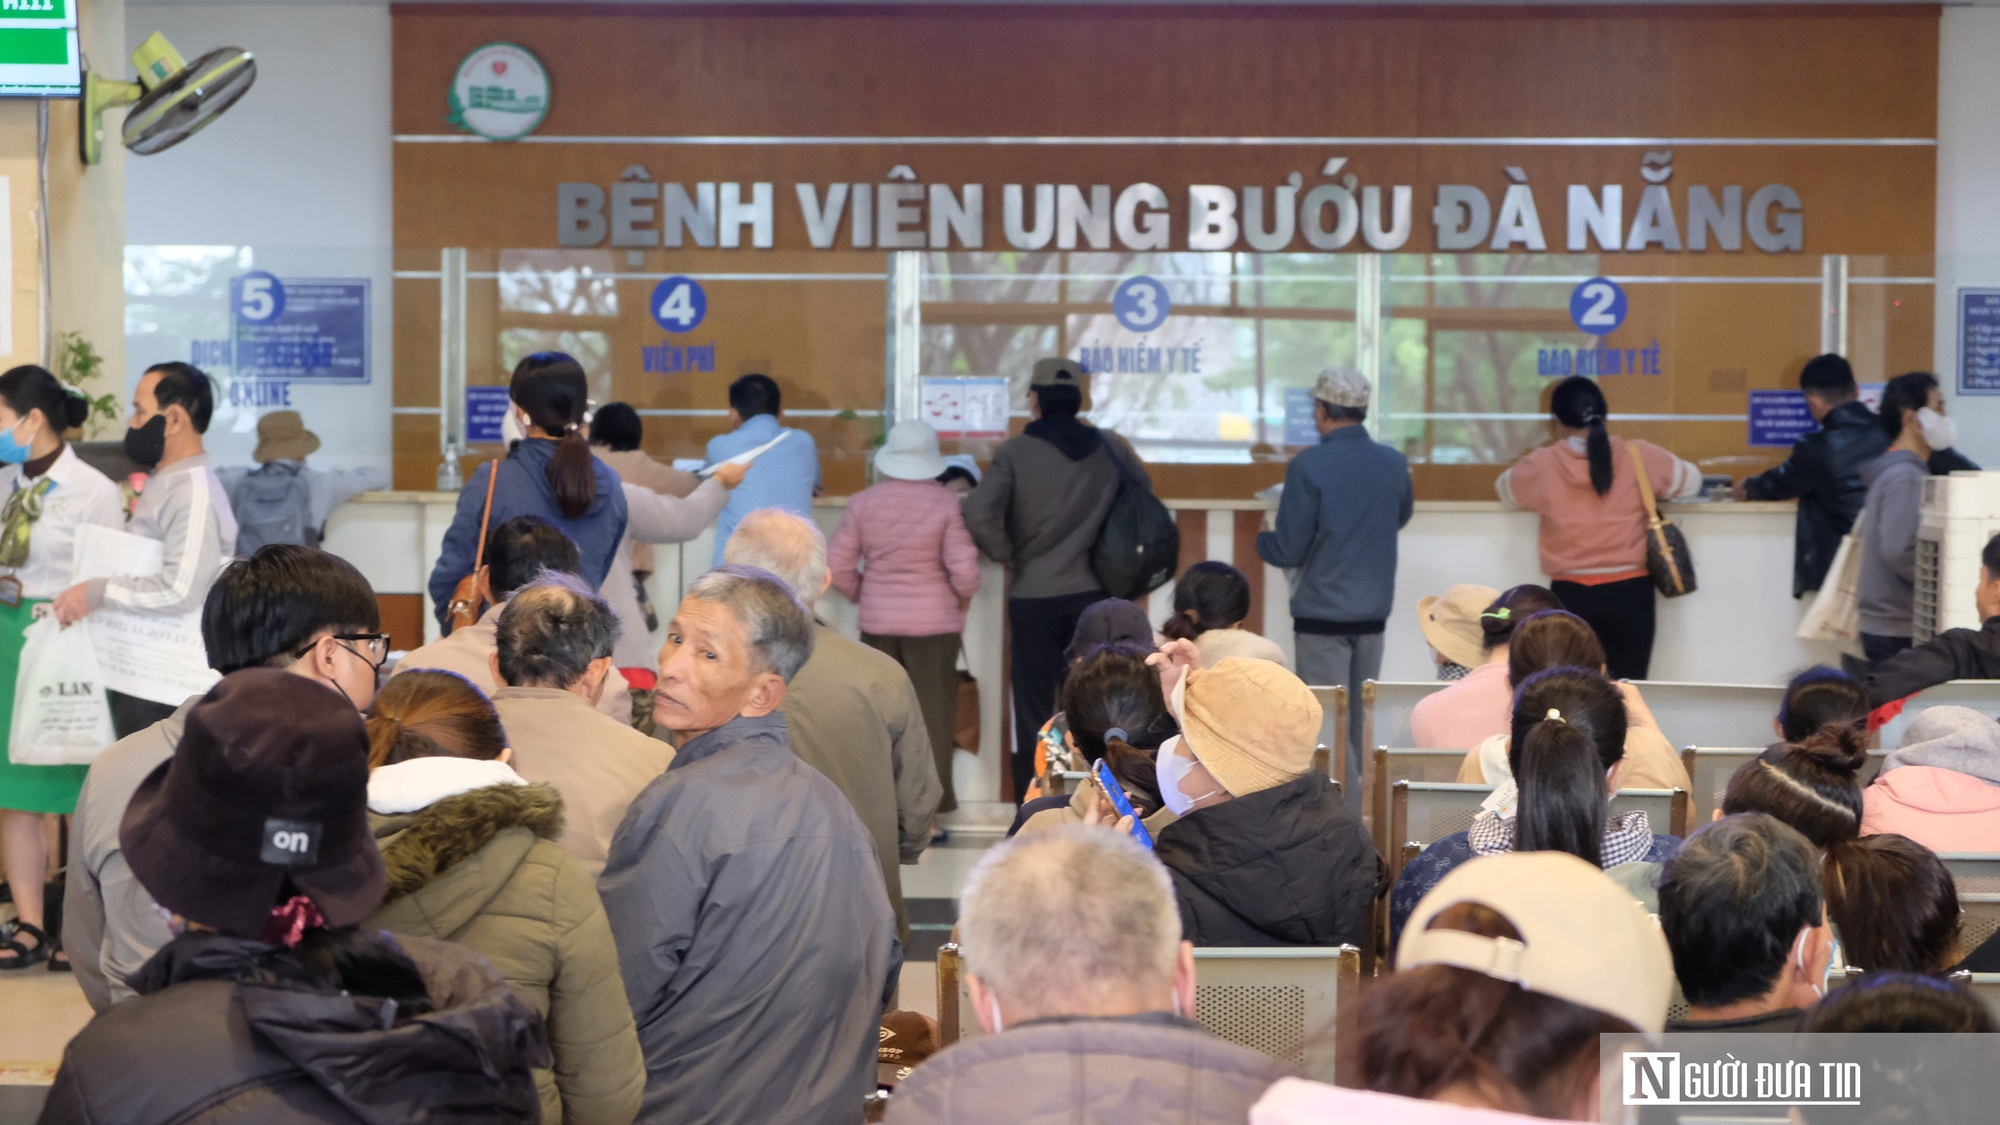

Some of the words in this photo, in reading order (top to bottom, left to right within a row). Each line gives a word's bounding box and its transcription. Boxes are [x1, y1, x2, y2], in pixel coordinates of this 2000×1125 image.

[558, 165, 773, 266] BỆNH
[1003, 182, 1171, 250] UNG
[1188, 157, 1412, 250] BƯỚU
[1433, 166, 1547, 250] ĐÀ
[1566, 150, 1803, 252] NẴNG
[241, 278, 275, 320] 5
[659, 283, 695, 325] 4
[1125, 283, 1158, 325] 3
[1581, 283, 1615, 325] 2
[1166, 347, 1178, 374] Y
[1626, 348, 1636, 375] Y
[273, 830, 309, 853] on
